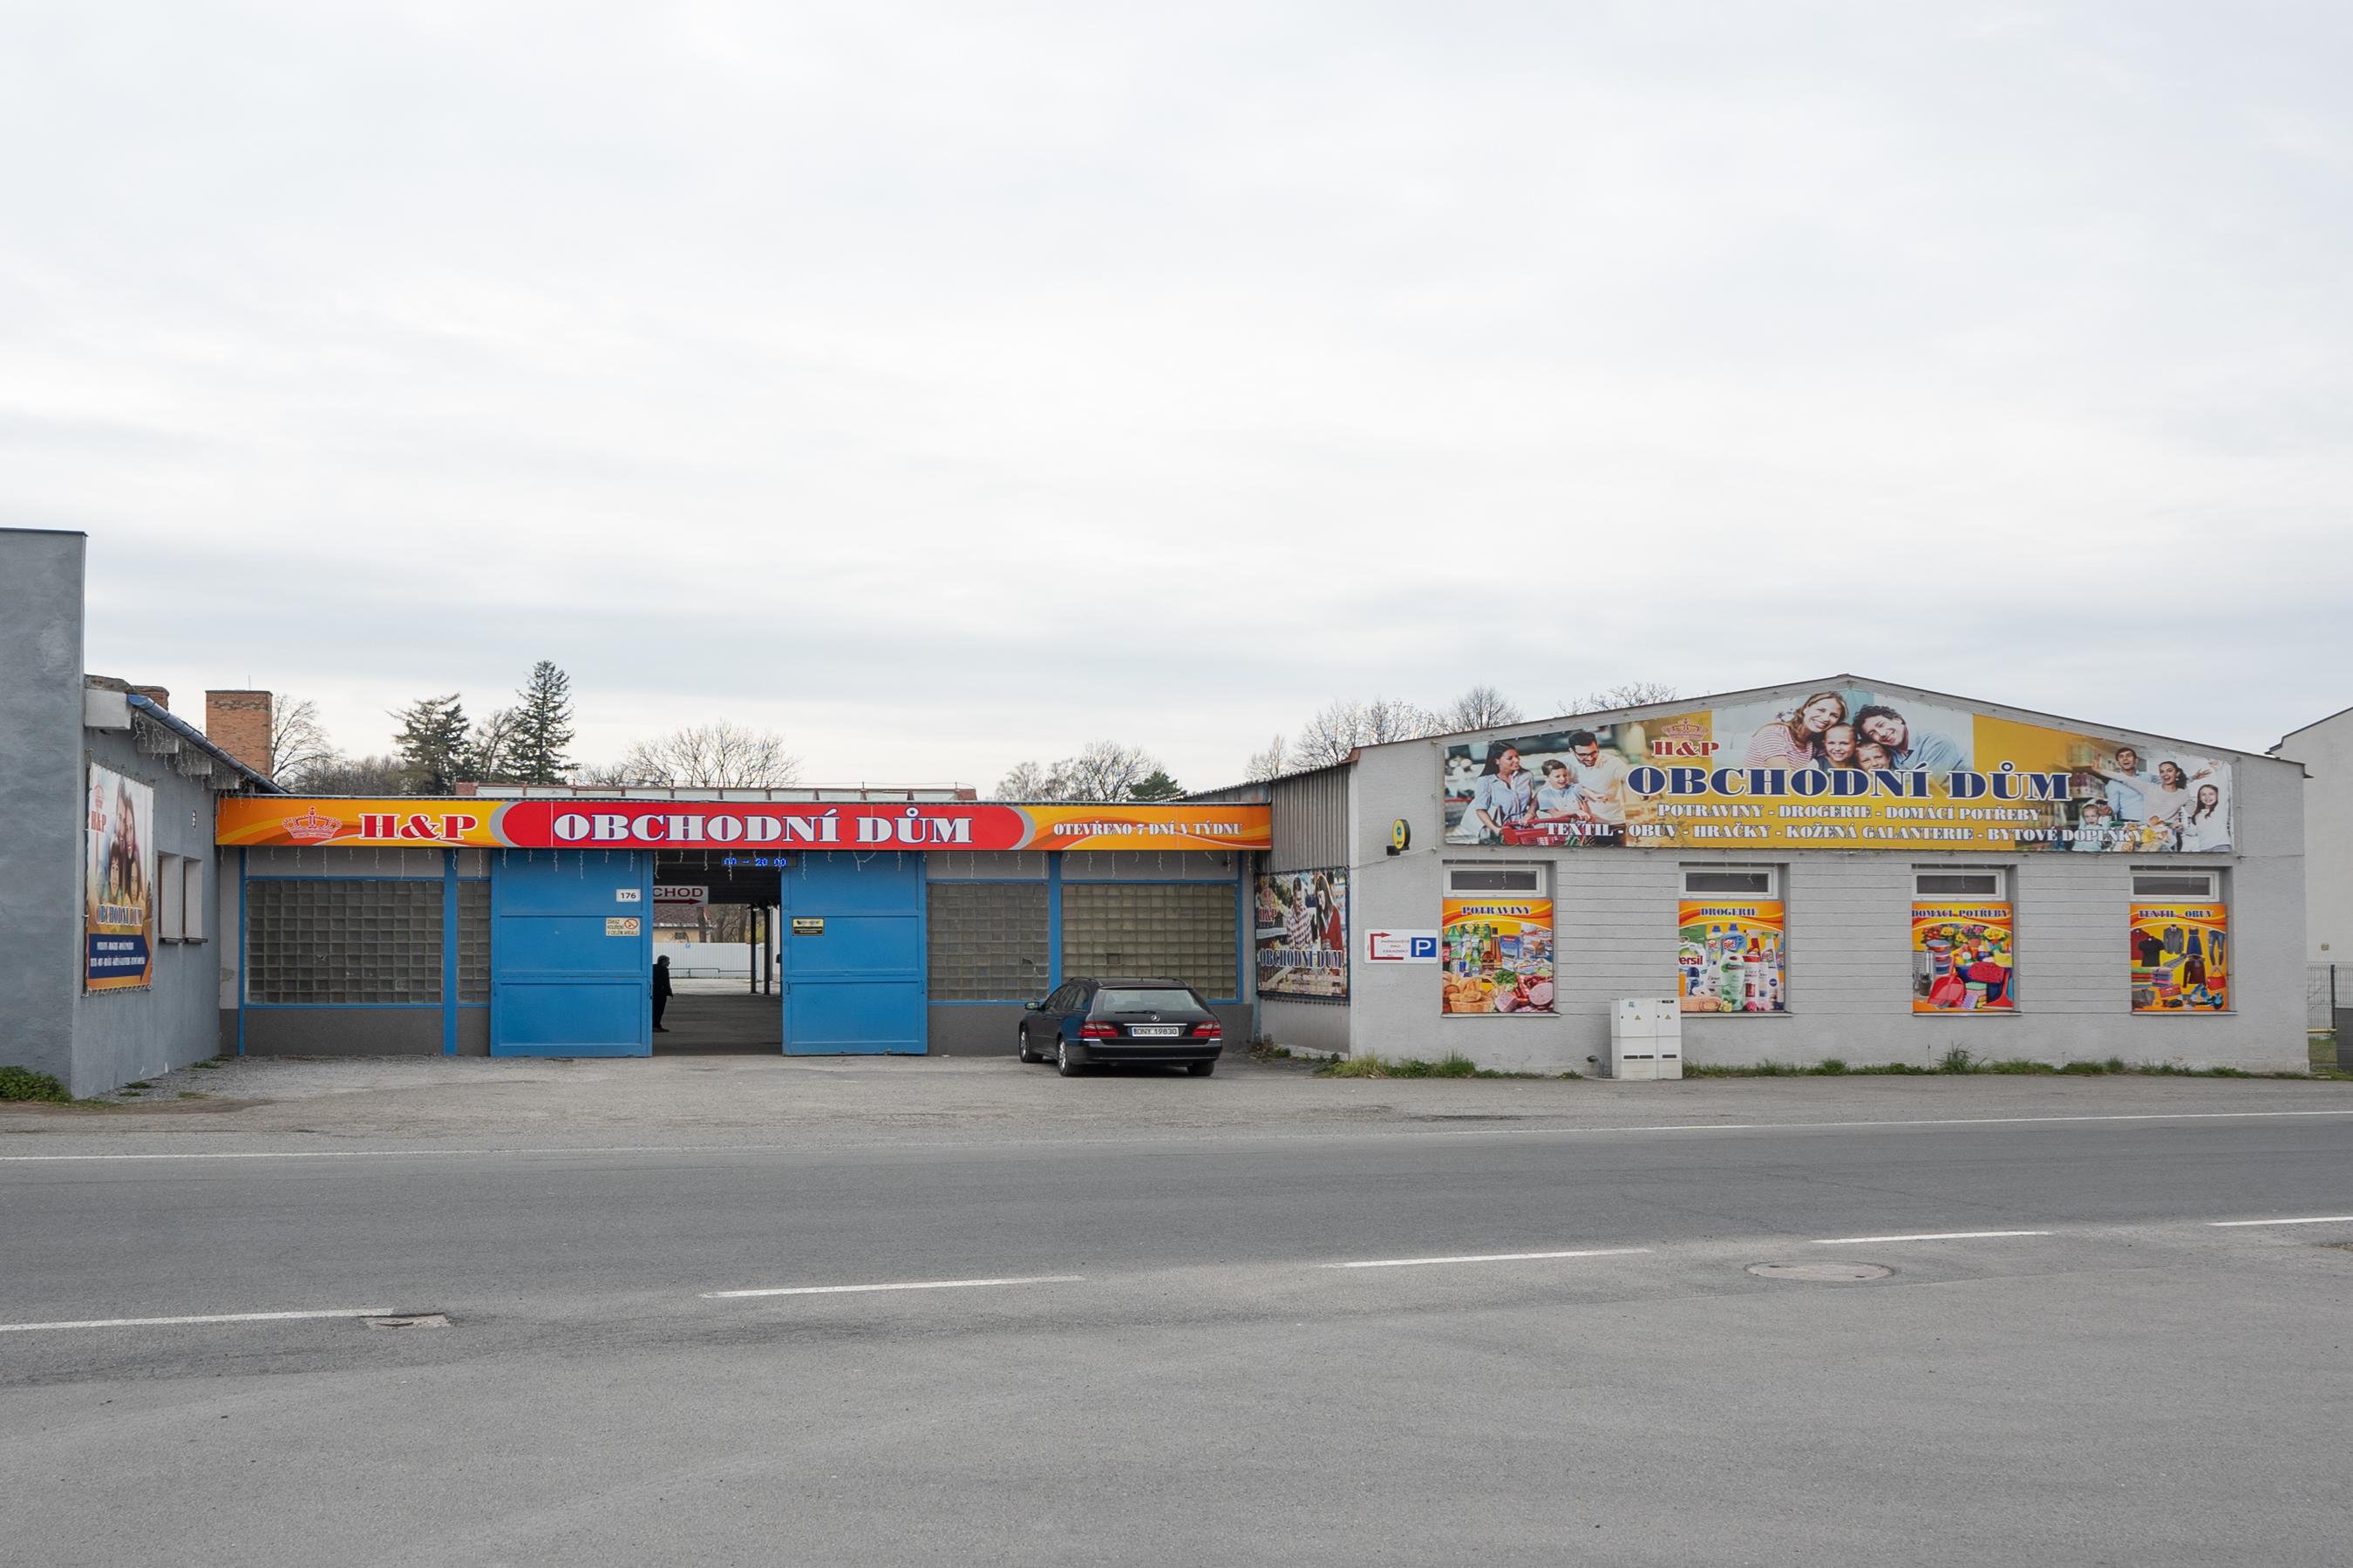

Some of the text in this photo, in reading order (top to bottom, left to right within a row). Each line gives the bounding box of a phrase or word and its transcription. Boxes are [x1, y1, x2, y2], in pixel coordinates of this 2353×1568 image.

[1652, 740, 1720, 757] H&P
[1627, 760, 2072, 801] OBCHODNÍ DŮM
[1658, 804, 1764, 818] POTRAVINY
[1778, 805, 1872, 818] DROGERIE
[1885, 804, 1954, 820] DOMÁCÍ
[1959, 805, 2041, 821] POTŘEBY
[358, 813, 477, 840] H&P
[553, 806, 973, 843] OBCHODNÍ DŮM
[1053, 819, 1242, 836] OTEVŘENO 7 DNÍ V TÝDNU
[1546, 822, 1613, 837] TEXTIL
[1629, 824, 1678, 838] OBUV
[1693, 822, 1771, 838] HRAČKY
[1785, 822, 1858, 838] KOŽENÁ
[1862, 825, 1974, 839] GALANTERIE
[1988, 824, 2057, 841] BYTOVÉ
[2063, 825, 2141, 842] DOPLŇKY
[1461, 906, 1532, 915] POTRAVINY
[1701, 907, 1758, 917] DROGERIE
[1911, 906, 2009, 918] DOMÁCÍ POTŘEBY
[1416, 940, 1431, 955] P
[1679, 954, 1703, 965] ersil
